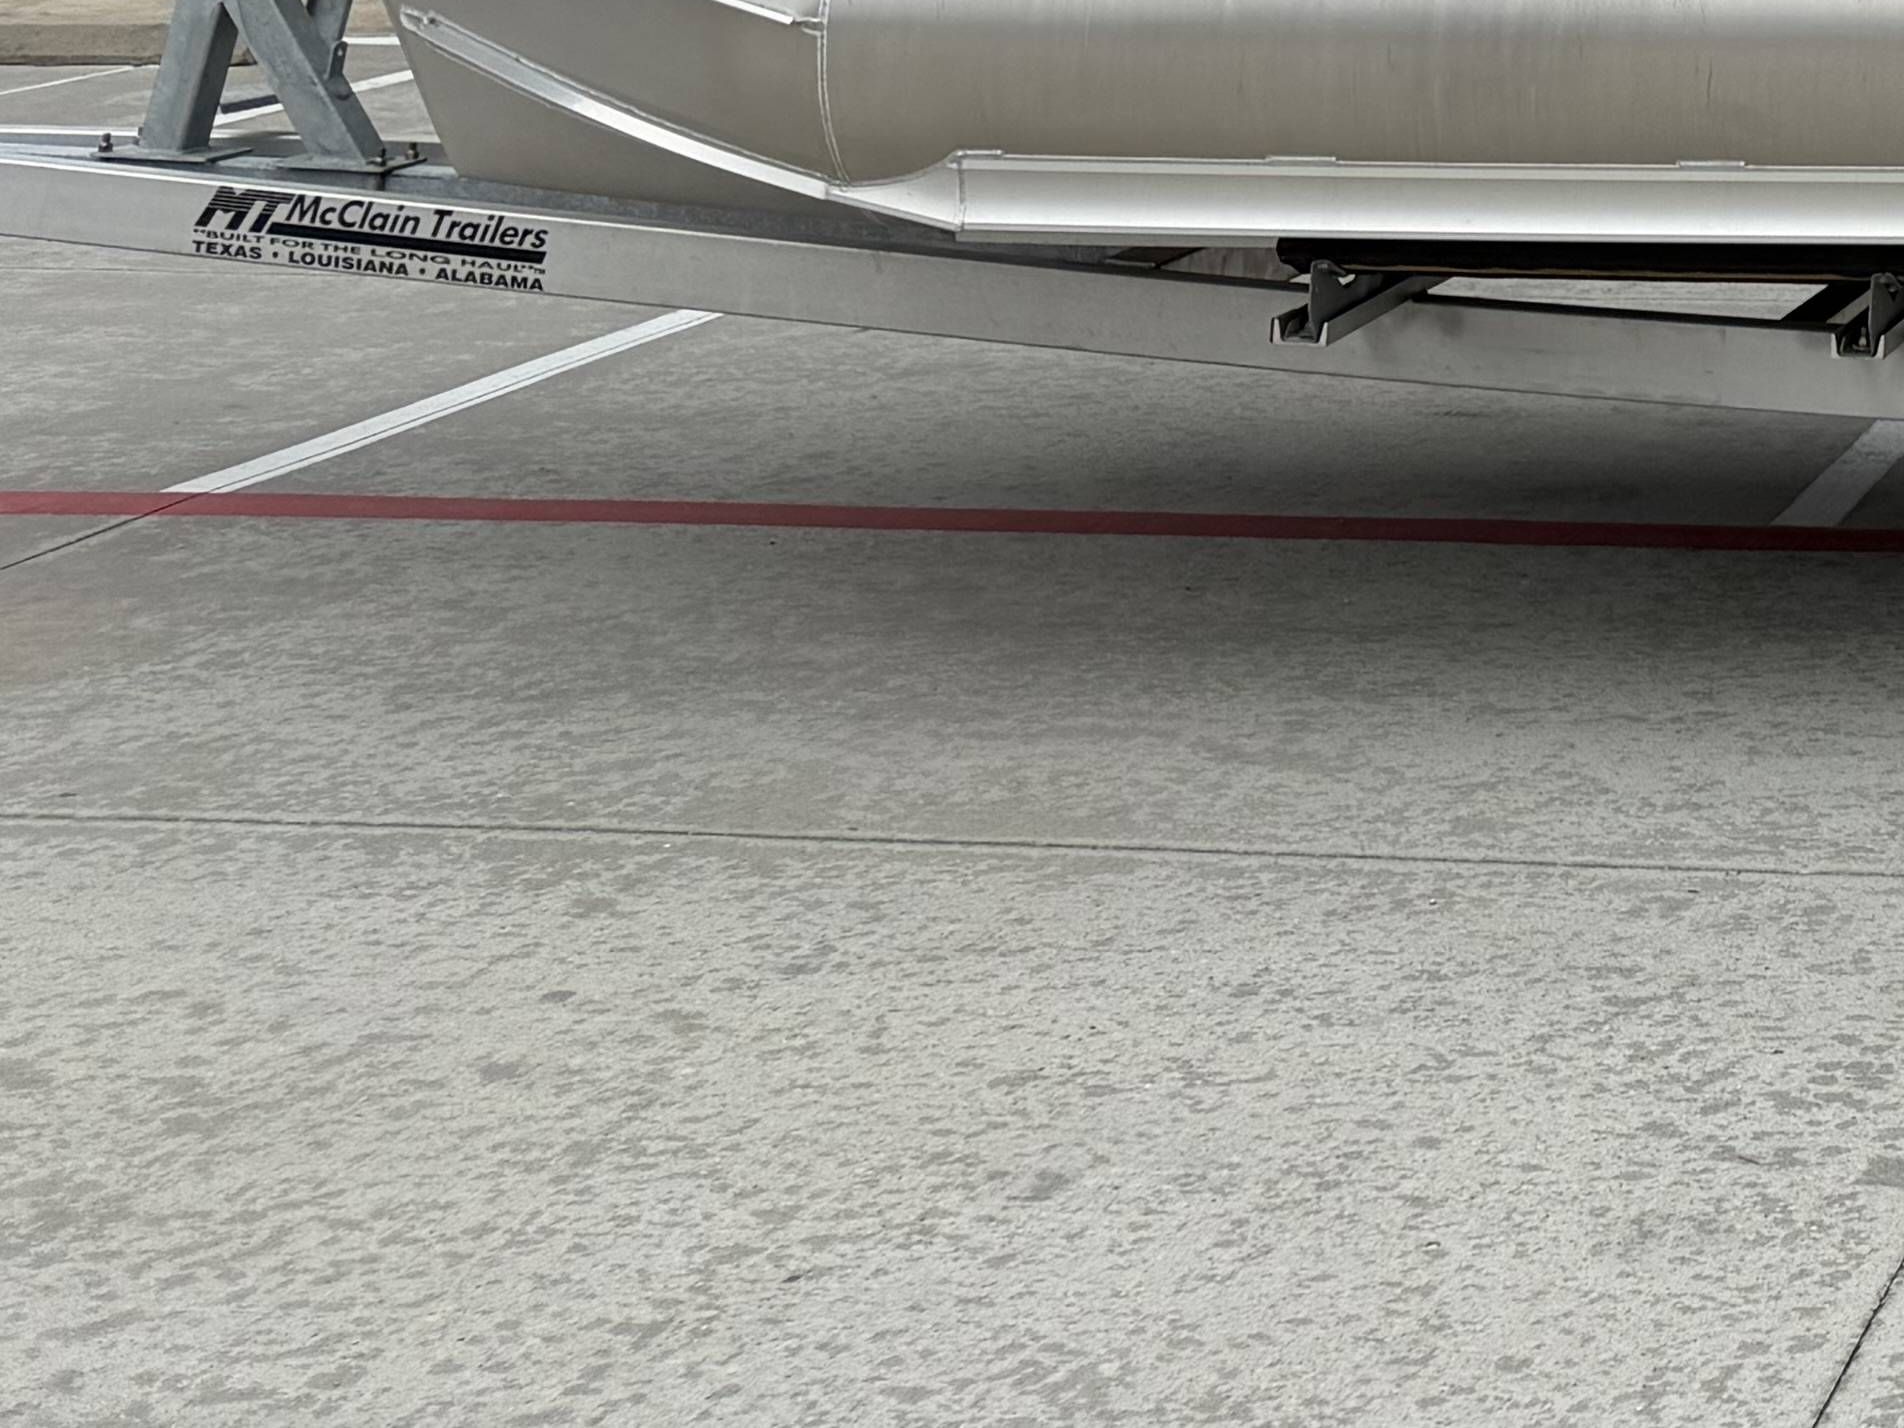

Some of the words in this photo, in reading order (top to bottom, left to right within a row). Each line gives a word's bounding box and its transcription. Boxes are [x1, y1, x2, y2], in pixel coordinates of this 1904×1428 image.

[285, 195, 420, 235] McClain
[431, 210, 549, 249] Trailers
[192, 239, 262, 259] TEXAS
[288, 251, 408, 276] LOUISIANA
[435, 268, 544, 292] ALABAMA
[269, 237, 315, 249] FOR
[320, 243, 361, 255] THE
[370, 248, 450, 265] LONG
